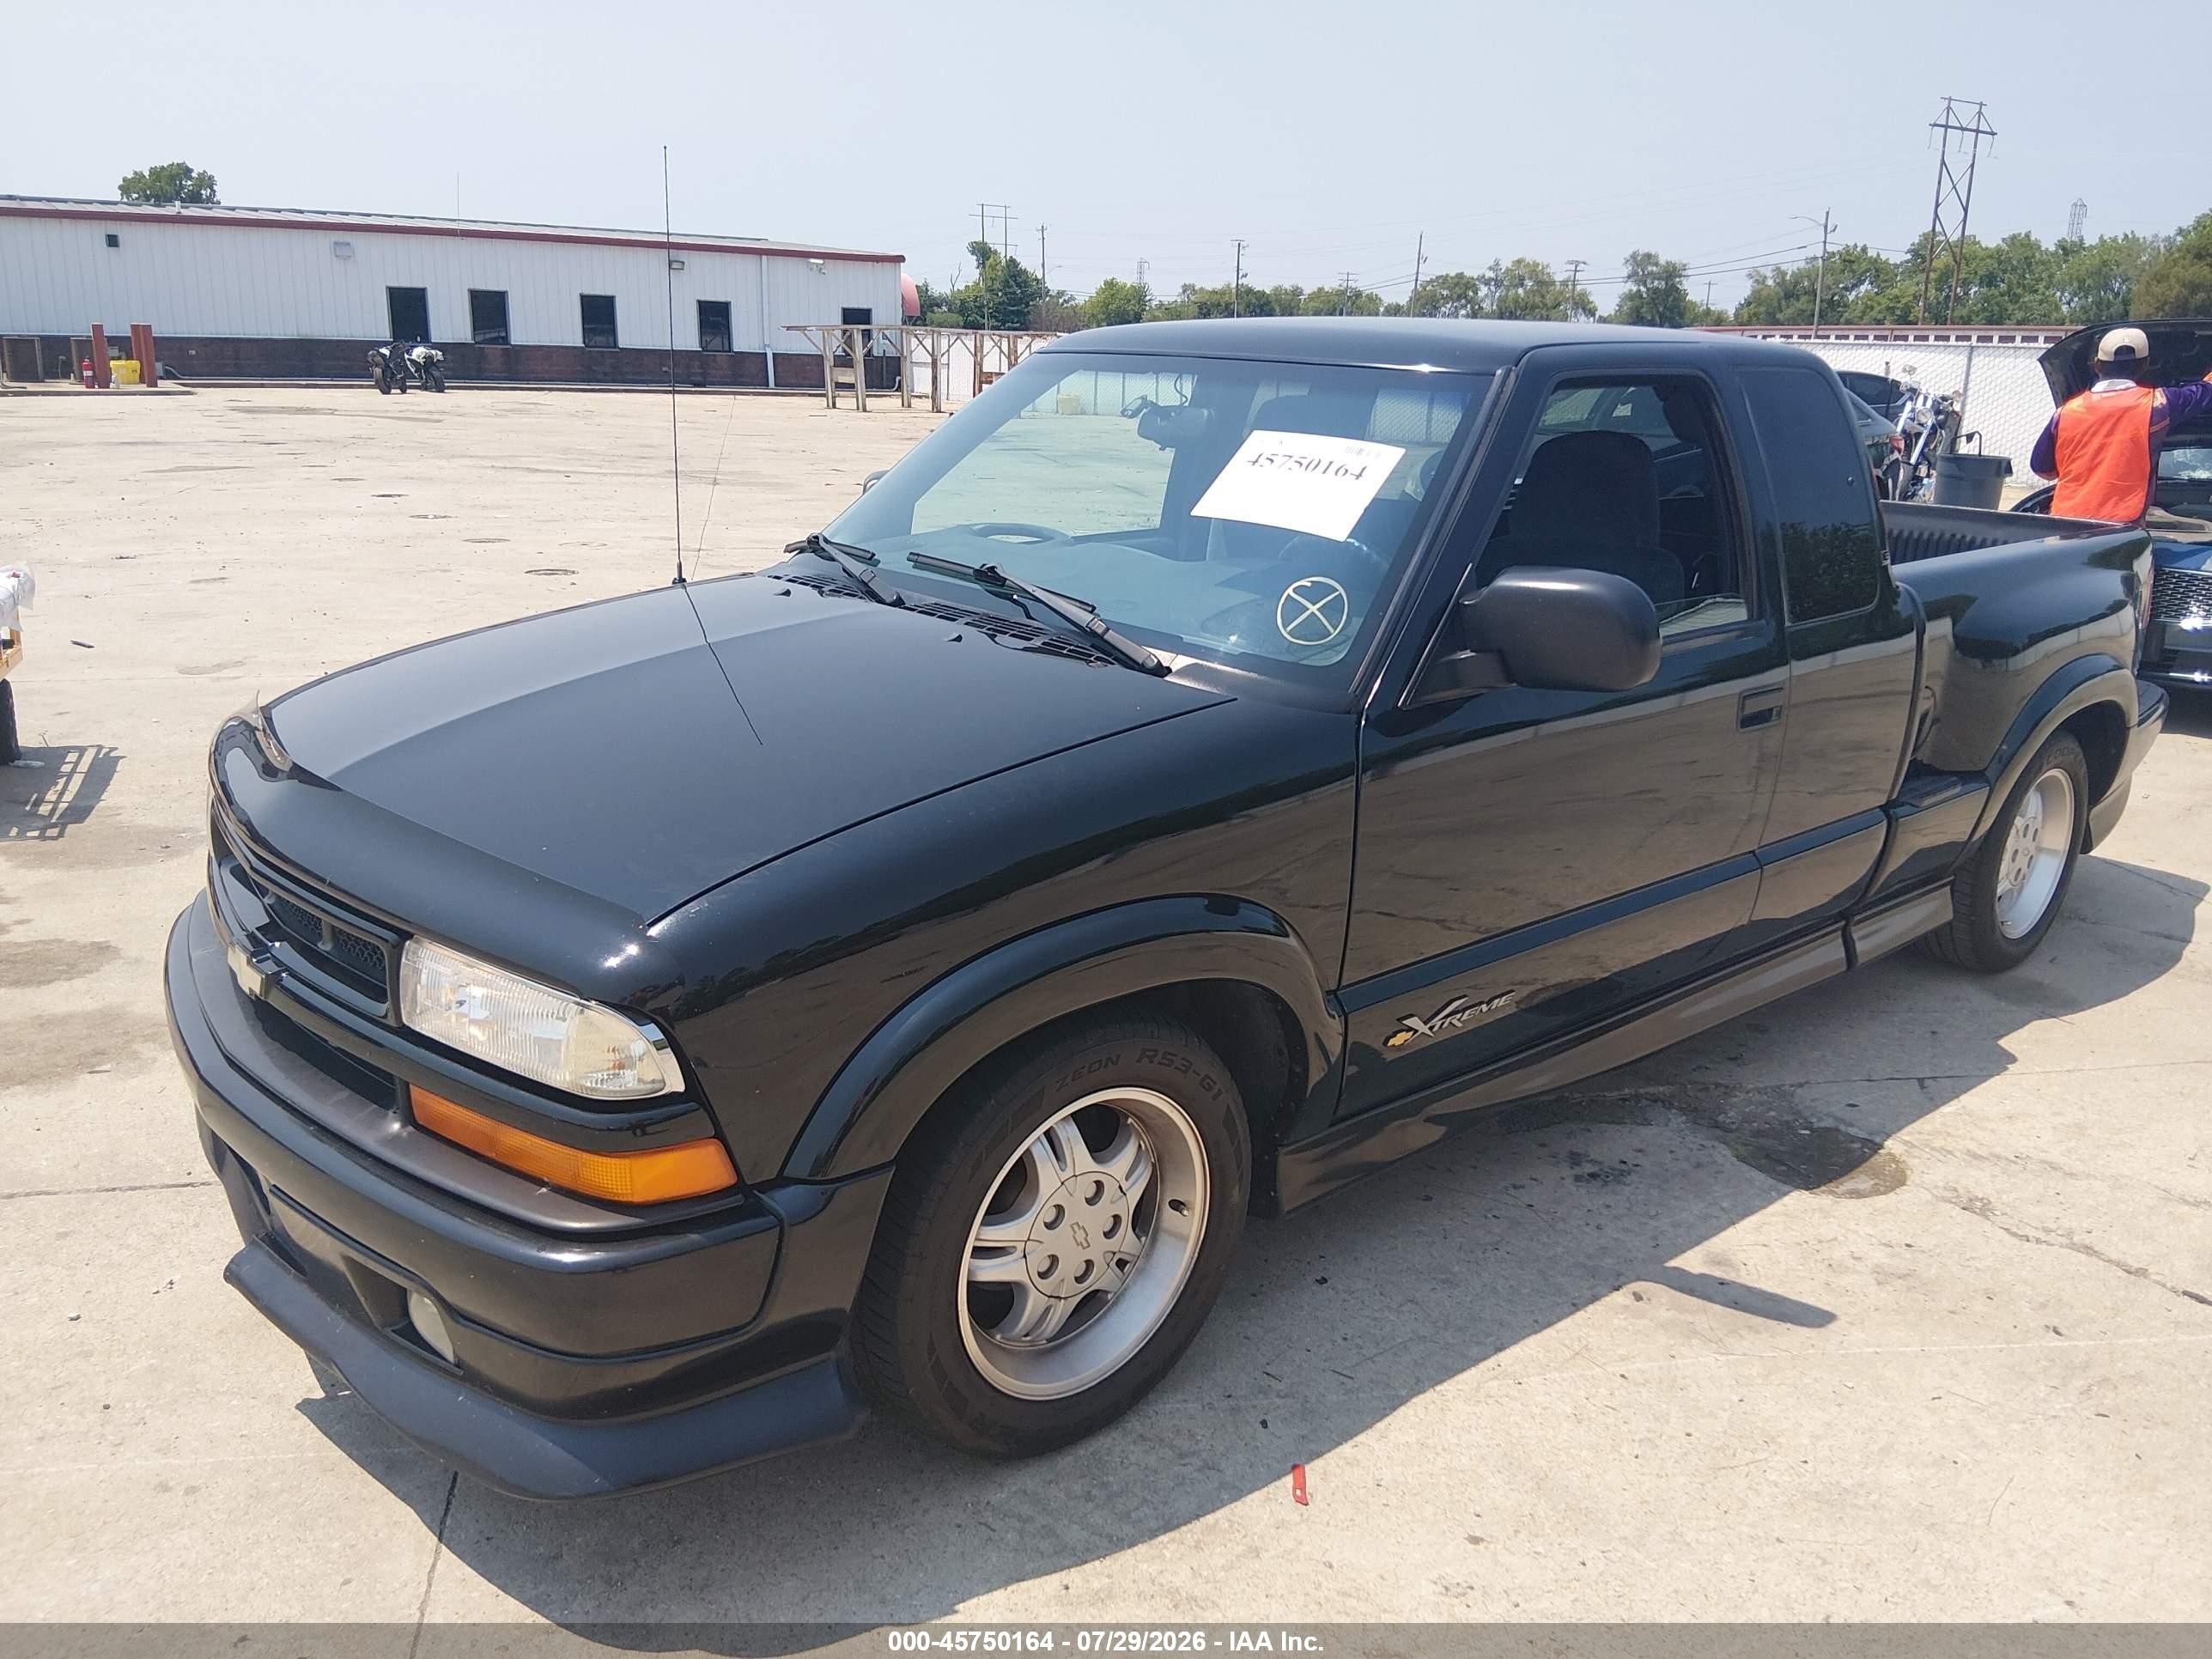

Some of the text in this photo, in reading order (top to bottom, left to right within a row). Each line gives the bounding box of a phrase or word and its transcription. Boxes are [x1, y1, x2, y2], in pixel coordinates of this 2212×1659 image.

[1247, 453, 1368, 480] 45750164
[1054, 1048, 1224, 1102] ZEON RS3-G1
